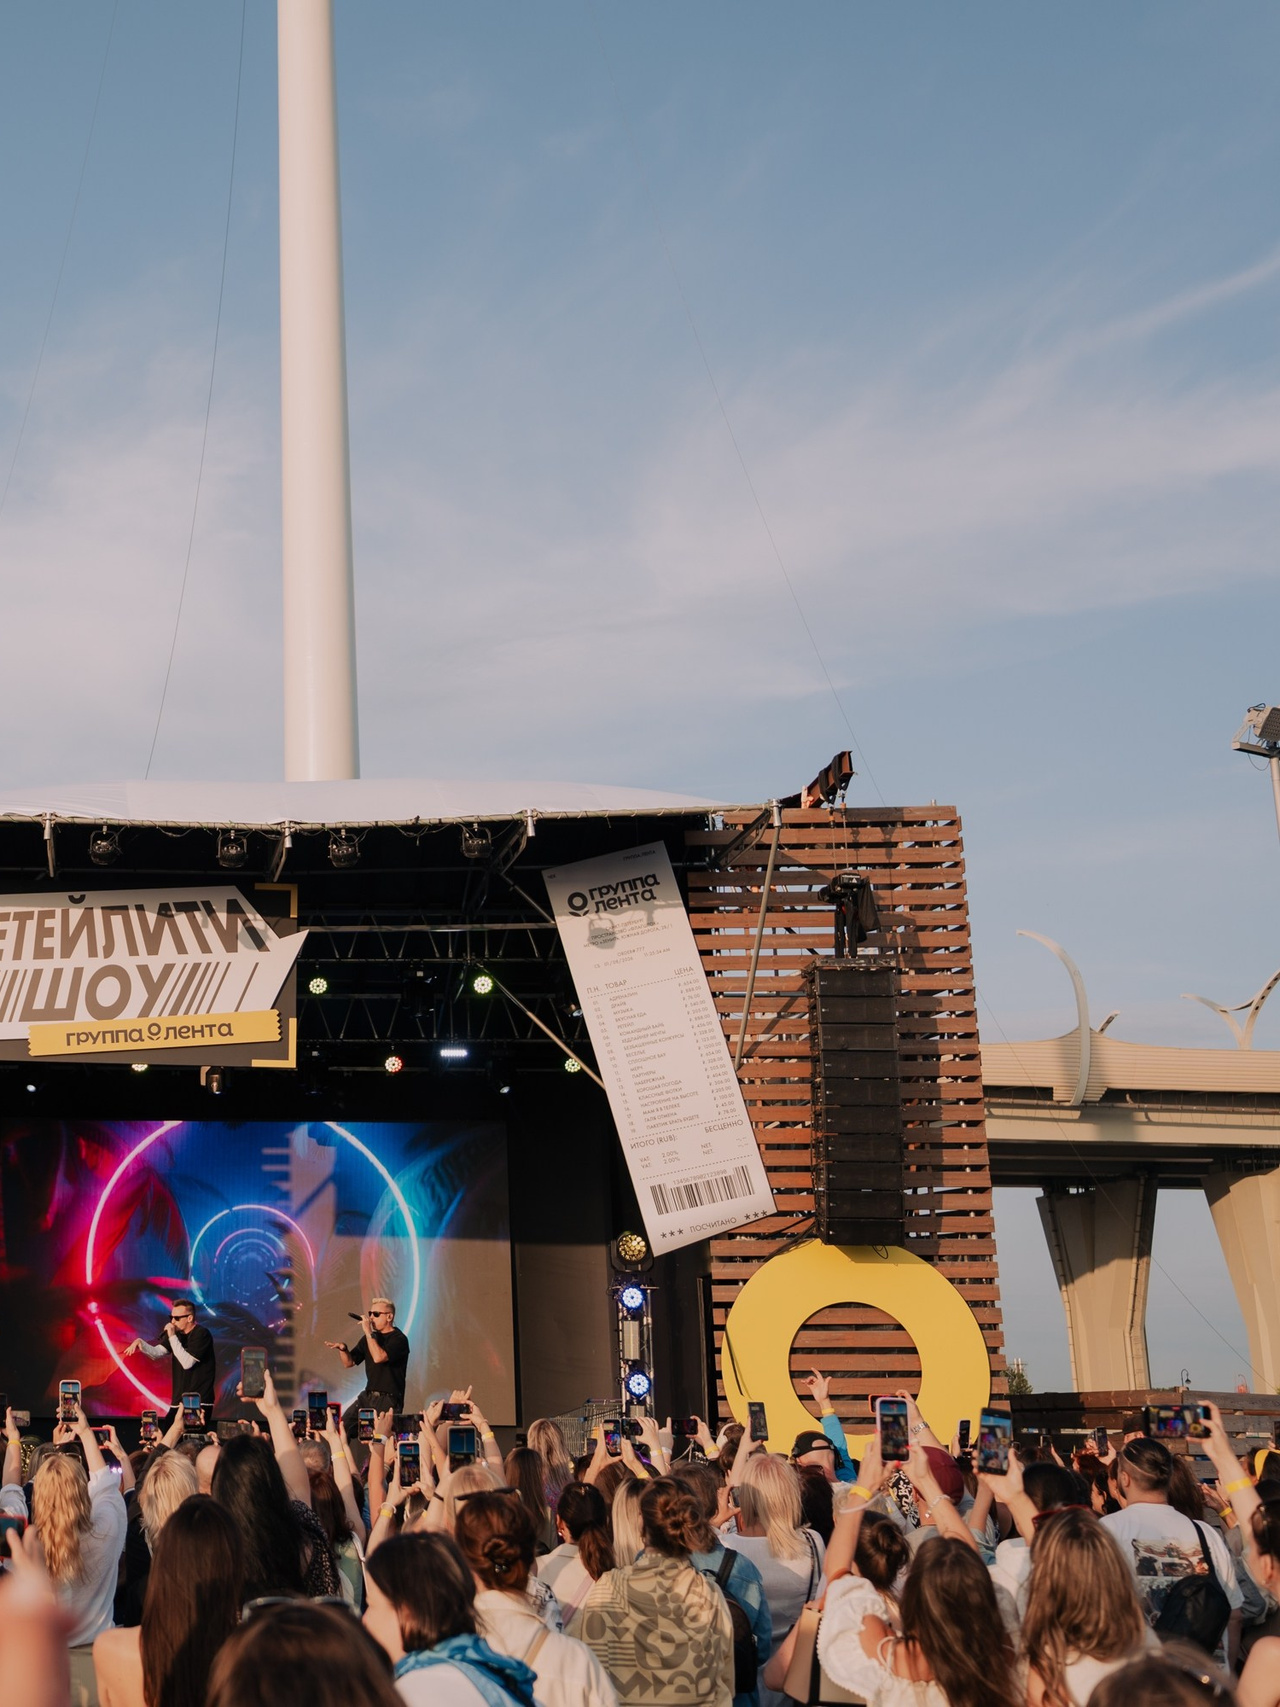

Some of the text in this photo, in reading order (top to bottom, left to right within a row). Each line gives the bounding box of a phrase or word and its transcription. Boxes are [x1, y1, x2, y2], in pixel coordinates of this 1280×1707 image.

[588, 874, 660, 900] группа
[595, 888, 656, 913] лента
[605, 979, 627, 989] ТОВАР
[674, 966, 693, 975] ЦЕНА
[18, 963, 176, 1022] ШОУ
[66, 1022, 233, 1046] группа лента
[619, 1025, 651, 1036] КОМАНДНЫЙ
[658, 1033, 684, 1042] КОНКУРСЫ
[634, 1075, 665, 1085] НАБЕРЕЖНАЯ
[636, 1084, 660, 1092] ХОРОШАЯ
[638, 1091, 663, 1100] КЛАССНЫЕ
[640, 1097, 670, 1107] НАСТРОЕНИЕ
[630, 1139, 656, 1149] ИТОГО
[704, 1120, 744, 1133] БЕСЦЕННО
[690, 1217, 737, 1233] ПОСЧИТАНО
